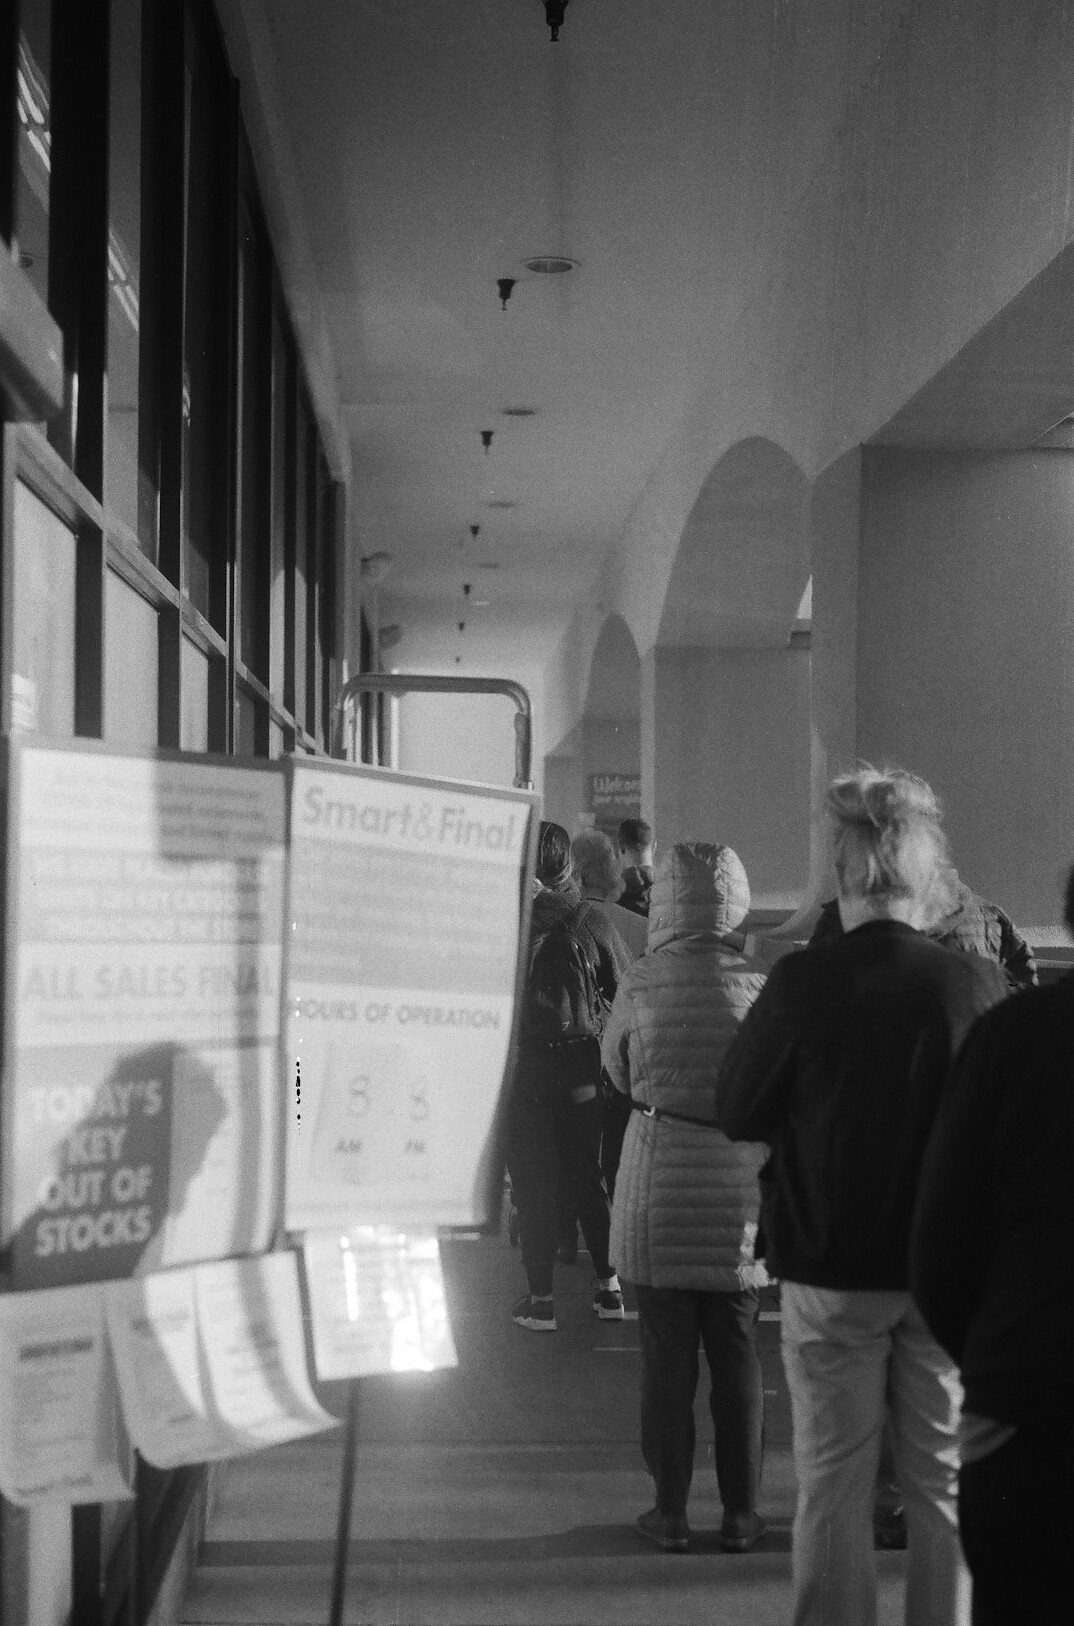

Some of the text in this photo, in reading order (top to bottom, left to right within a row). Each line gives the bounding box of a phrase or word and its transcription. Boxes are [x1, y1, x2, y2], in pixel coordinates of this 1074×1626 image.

[303, 785, 516, 850] Smart&Final
[24, 964, 274, 1000] ALL SALES FINAL
[365, 1002, 391, 1024] OF
[396, 1004, 501, 1029] OPERATION
[28, 1079, 163, 1121] TODAY'S
[67, 1126, 127, 1165] KEY
[37, 1165, 152, 1211] OUT OF
[35, 1205, 152, 1258] STOCKS
